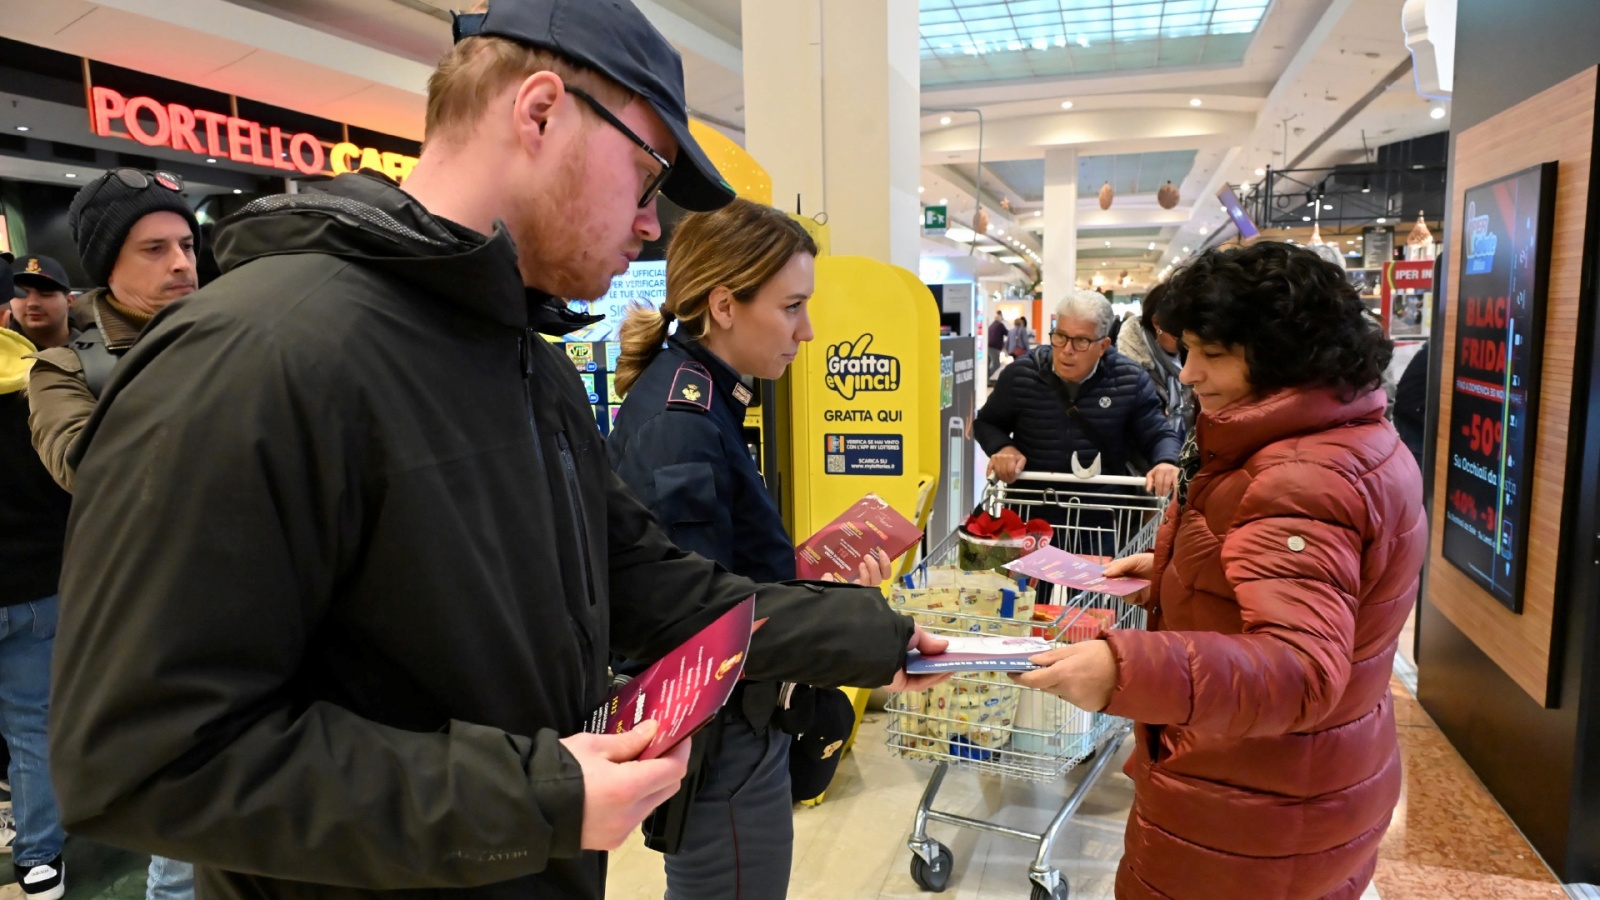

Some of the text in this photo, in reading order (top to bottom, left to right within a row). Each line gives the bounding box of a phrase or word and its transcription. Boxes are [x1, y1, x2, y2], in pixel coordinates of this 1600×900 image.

[92, 86, 324, 175] PORTELLO
[1395, 270, 1419, 280] IPER
[626, 280, 666, 288] VERIFICAR
[637, 290, 666, 298] VINCITE
[1466, 296, 1510, 328] BLAC
[573, 347, 587, 356] VIP
[1461, 337, 1506, 374] FRIDA
[829, 355, 890, 373] Gratta
[826, 376, 834, 388] e
[824, 410, 902, 422] GRATTA QUI
[1454, 454, 1461, 468] Su
[1462, 458, 1487, 482] Occhiali
[1488, 470, 1497, 486] da
[1480, 506, 1496, 531] -3
